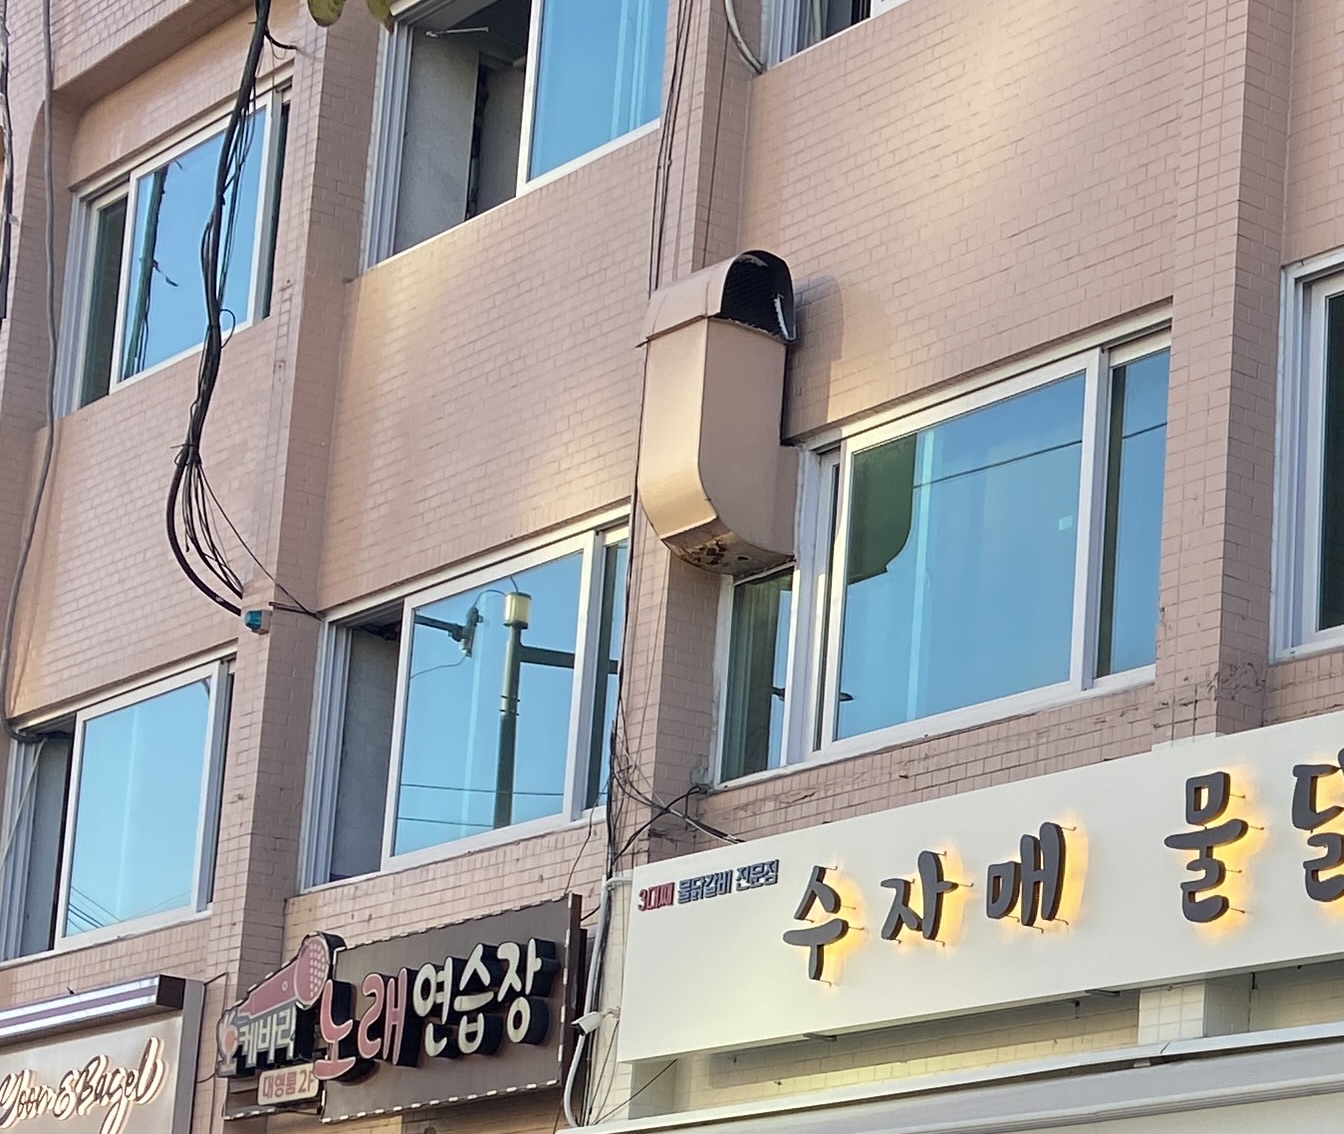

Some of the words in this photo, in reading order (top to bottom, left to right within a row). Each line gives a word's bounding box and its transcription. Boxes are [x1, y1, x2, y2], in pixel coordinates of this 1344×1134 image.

[638, 882, 675, 911] 3대째
[678, 869, 733, 904] 물닭갈비
[736, 859, 779, 891] 전문점
[783, 820, 1067, 981] 수자매
[262, 1071, 297, 1099] 대형룸
